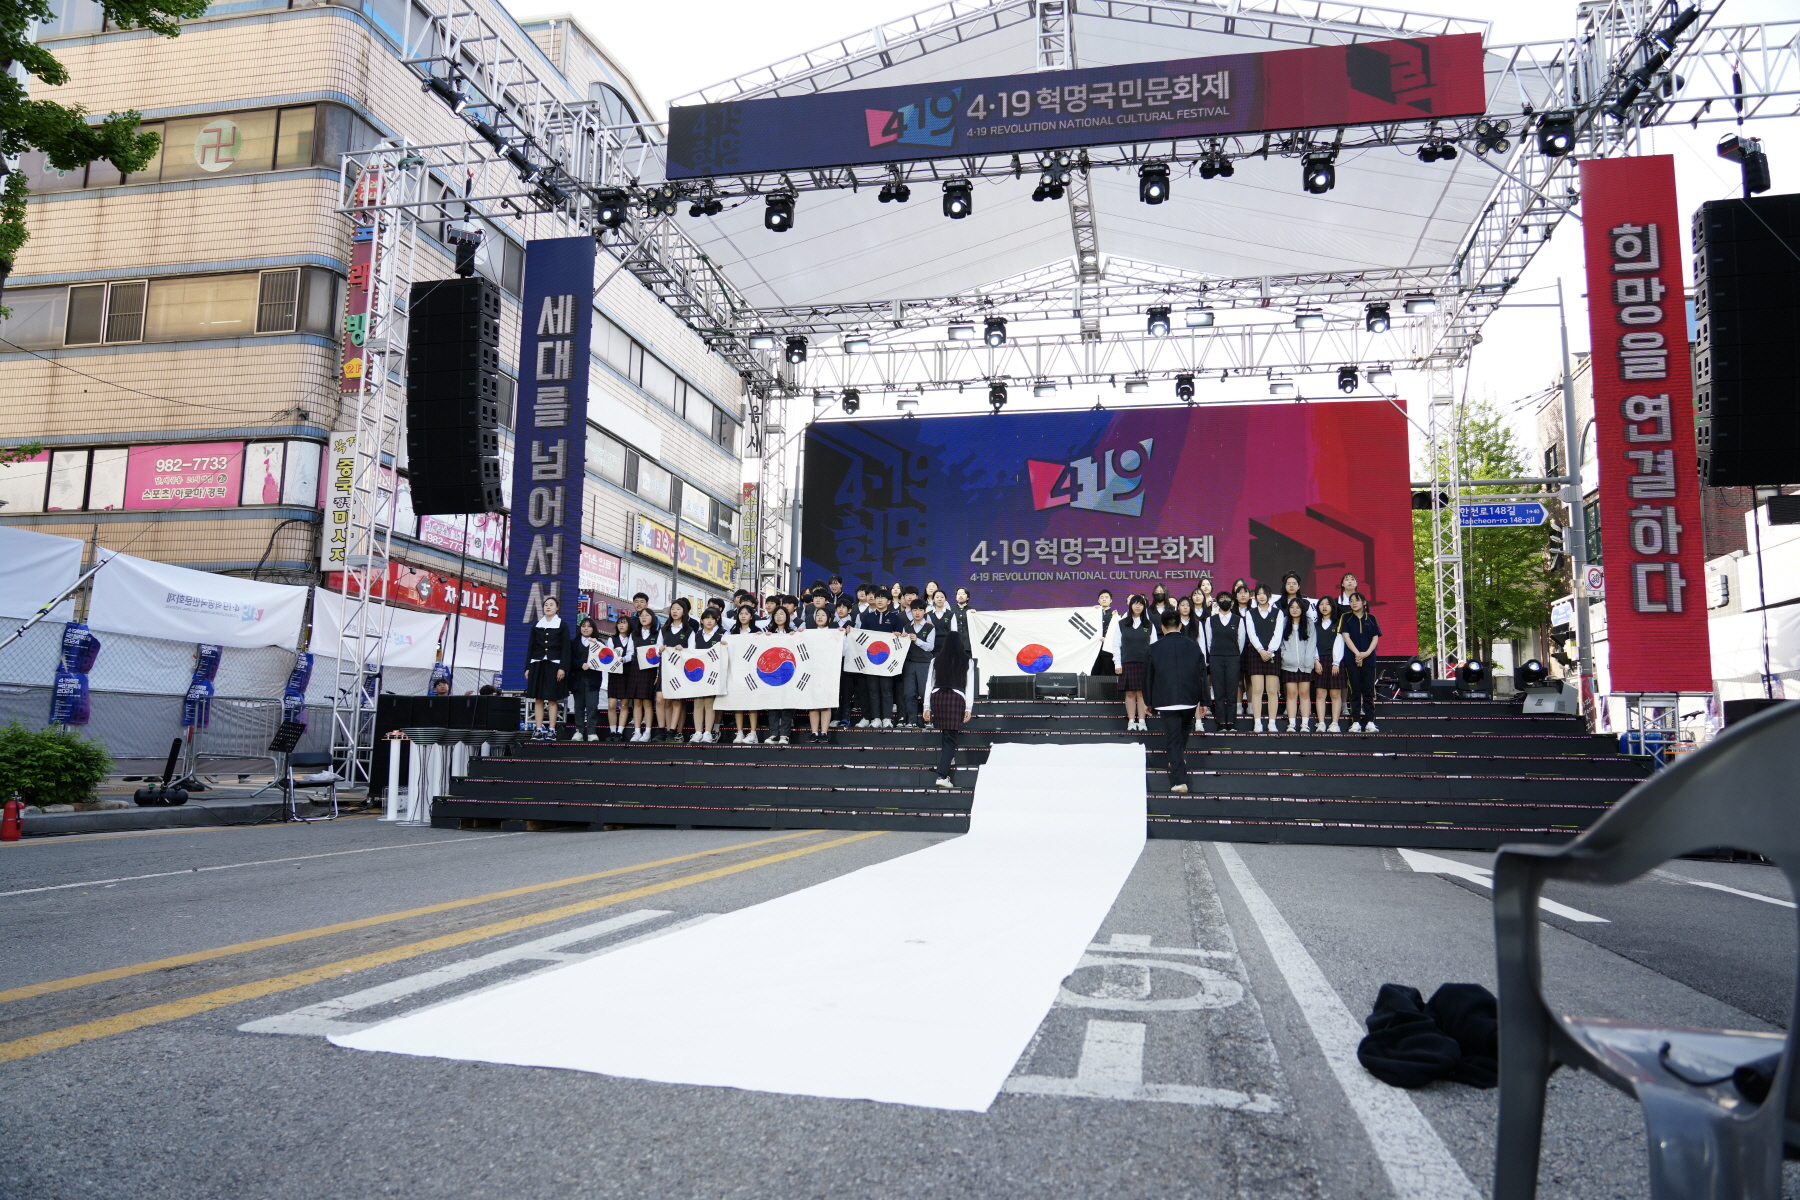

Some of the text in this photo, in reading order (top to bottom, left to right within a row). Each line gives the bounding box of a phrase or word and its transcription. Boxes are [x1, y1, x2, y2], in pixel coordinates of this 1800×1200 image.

[966, 70, 1230, 120] 4·19 혁명국민문화제
[990, 120, 1057, 135] REVOLUTION
[1059, 115, 1114, 130] NATIONAL
[1116, 110, 1175, 125] CULTURAL
[1176, 105, 1230, 120] FESTIVAL
[533, 294, 578, 429] 세대를
[1609, 222, 1687, 614] 희망을 연결하다
[156, 456, 228, 473] 982-7733
[1460, 505, 1516, 517] 한천로148길
[1510, 516, 1535, 524] 148-gil
[691, 544, 733, 586] 노래방
[970, 535, 1214, 566] 4·19 혁명국민문화제
[992, 571, 1054, 581] REVOLUTION
[1056, 571, 1107, 581] NATIONAL
[1109, 570, 1163, 580] CULTURAL
[1165, 569, 1214, 580] FESTIVAL
